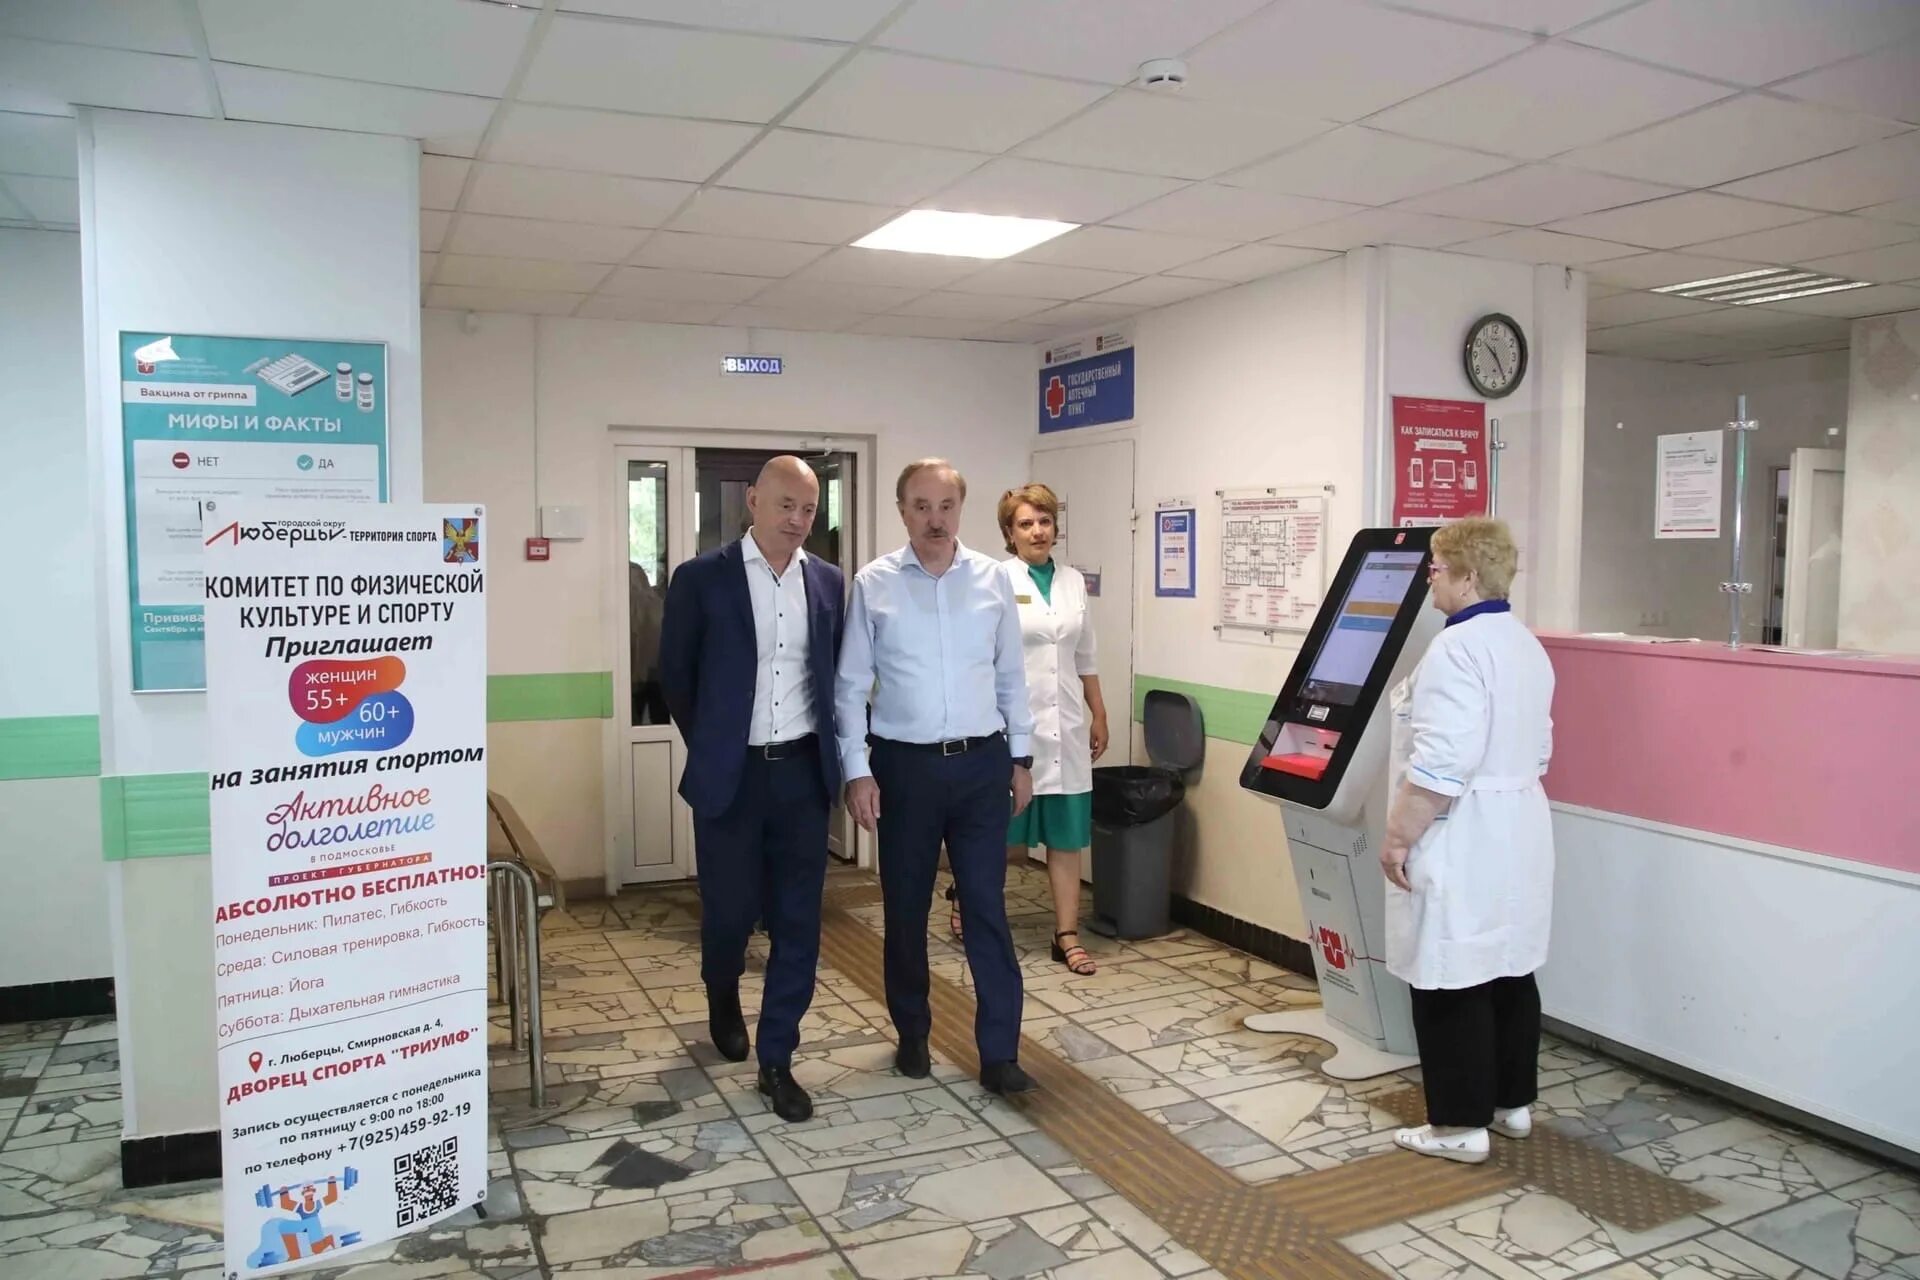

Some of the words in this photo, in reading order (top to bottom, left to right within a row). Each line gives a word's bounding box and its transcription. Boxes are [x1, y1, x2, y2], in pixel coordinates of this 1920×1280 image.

[726, 358, 780, 373] ВЫХОД
[140, 387, 190, 398] Вакцина
[193, 390, 205, 398] от
[208, 391, 248, 400] гриппа
[168, 413, 238, 430] МИФЫ
[245, 415, 259, 431] И
[265, 415, 341, 433] ФАКТЫ
[1401, 426, 1414, 435] КАК
[1415, 427, 1454, 437] ЗАПИСАТЬСЯ
[197, 456, 219, 467] НЕТ
[318, 458, 334, 469] ДА
[278, 519, 321, 528] городской
[323, 519, 346, 529] округ
[350, 530, 403, 542] ТЕРРИТОРИЯ
[406, 530, 437, 542] СПОРТА
[205, 575, 309, 599] КОМИТЕТ
[316, 575, 343, 597] ПО
[351, 569, 484, 597] ФИЗИЧЕСКОЙ
[240, 604, 350, 628] КУЛЬТУРЕ
[358, 604, 370, 625] И
[378, 601, 454, 624] СПОРТУ
[265, 634, 433, 663] Приглашает
[305, 668, 377, 685] женщин
[306, 690, 349, 710] 55+
[359, 702, 400, 723] 60+
[318, 725, 385, 746] мужчин
[211, 770, 242, 790] на
[250, 757, 368, 785] занятия
[375, 746, 484, 774] спортом
[266, 783, 431, 825] Активное
[267, 812, 435, 852] долголетие
[320, 844, 396, 862] ПОДМОСКОВЬЕ
[273, 869, 327, 884] ПРОЕКТ
[339, 854, 430, 875] ГУБЕРНАТОРА
[215, 885, 356, 924] АБСОЛЮТНО
[362, 864, 486, 897] БЕСПЛАТНО!
[216, 918, 318, 948] Понедельник:
[323, 906, 386, 929] Пилатес,
[390, 896, 447, 916] Гибкость
[217, 955, 266, 977] Среда:
[272, 944, 338, 965] Силовая
[427, 915, 486, 935] Гибкость
[218, 984, 284, 1010] Пятница:
[289, 975, 325, 993] Йога
[218, 1012, 285, 1039] Суббота:
[288, 992, 385, 1024] Дыхательная
[389, 972, 461, 1000] гимнастика
[268, 1058, 277, 1068] г.
[280, 1046, 344, 1066] Люберцы,
[347, 1027, 421, 1051] Смирновская
[422, 1024, 433, 1034] д.
[435, 1018, 444, 1029] 4,
[226, 1071, 308, 1105] ДВОРЕЦ
[312, 1053, 386, 1081] СПОРТА
[391, 1027, 479, 1060] "ТРИУМФ"
[231, 1120, 280, 1140] Запись
[284, 1094, 389, 1128] осуществляется
[392, 1092, 398, 1101] с
[402, 1068, 481, 1098] понедельника
[279, 1134, 297, 1145] по
[301, 1120, 357, 1141] пятницу
[360, 1118, 366, 1127] с
[369, 1108, 395, 1125] 9:00
[398, 1105, 414, 1116] по
[416, 1092, 445, 1110] 18:00
[244, 1163, 262, 1176] по
[266, 1147, 333, 1170] телефону
